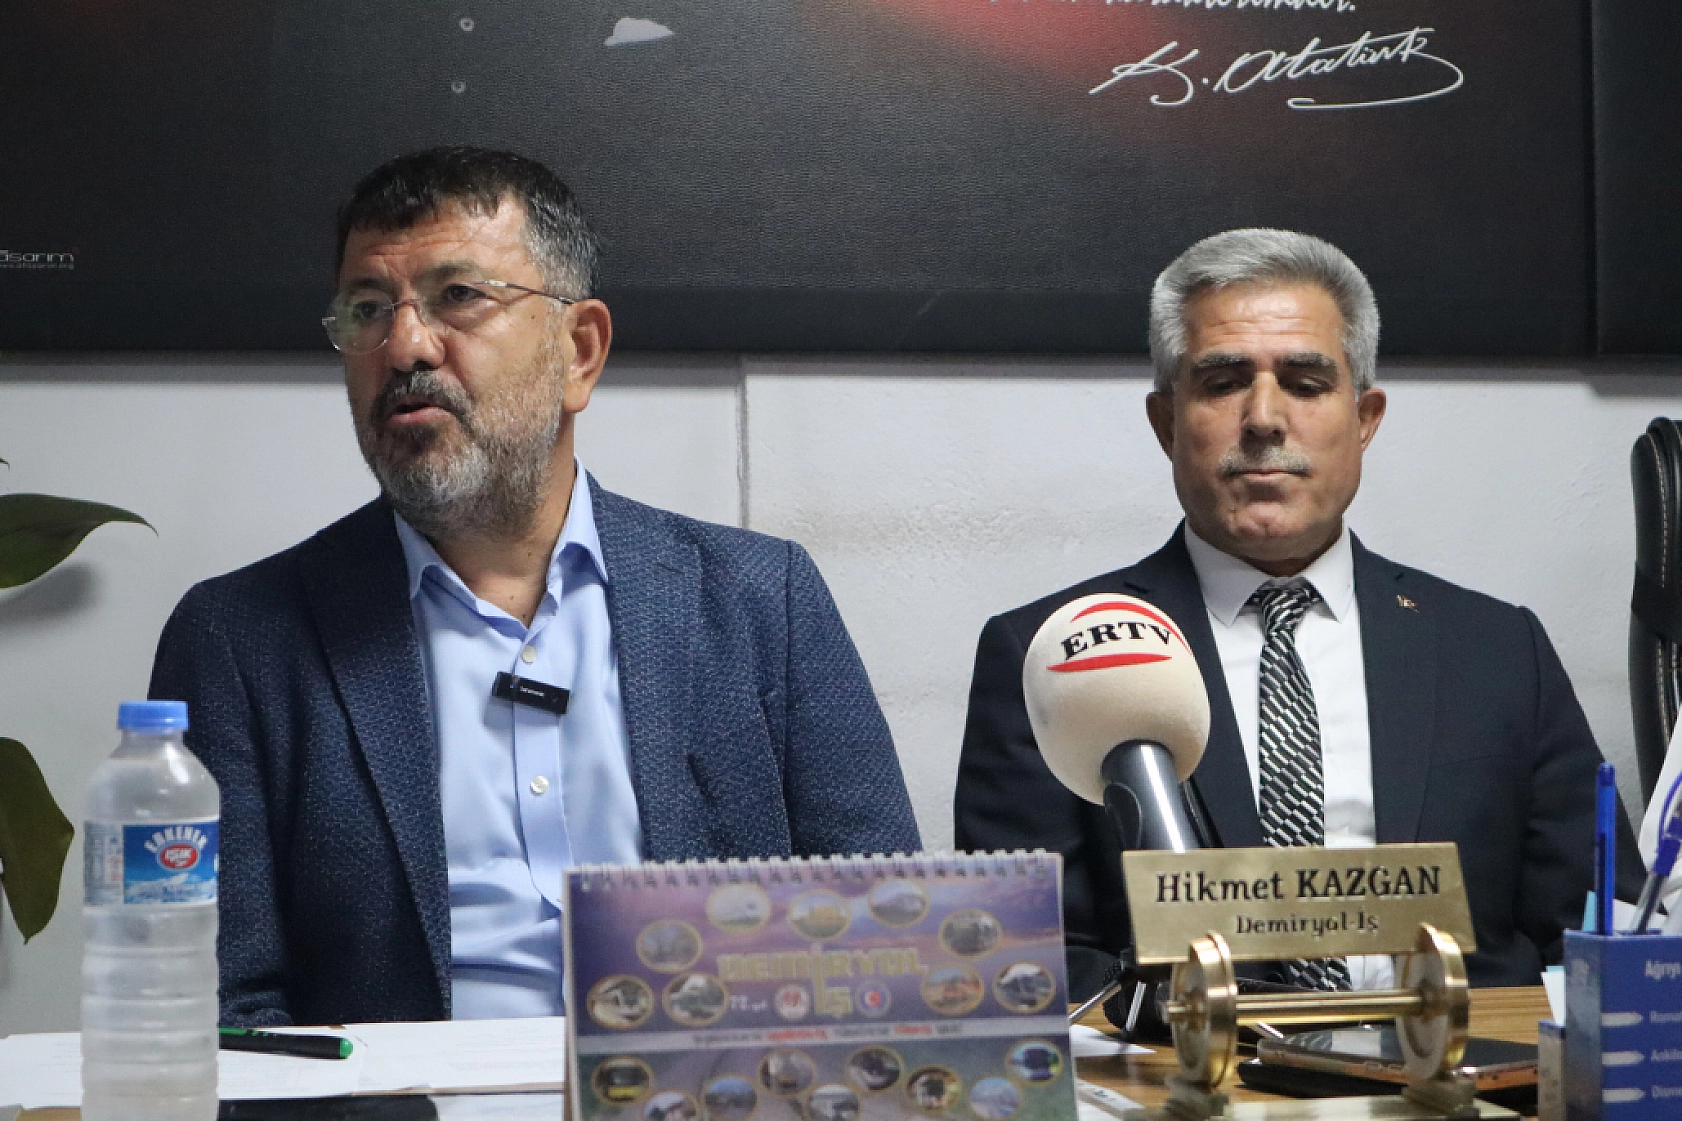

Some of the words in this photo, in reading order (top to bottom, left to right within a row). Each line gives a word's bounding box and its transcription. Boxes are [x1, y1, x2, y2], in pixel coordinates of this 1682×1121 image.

[1060, 620, 1172, 661] ERTV
[1156, 871, 1284, 903] Hikmet
[1296, 865, 1441, 899] KAZGAN
